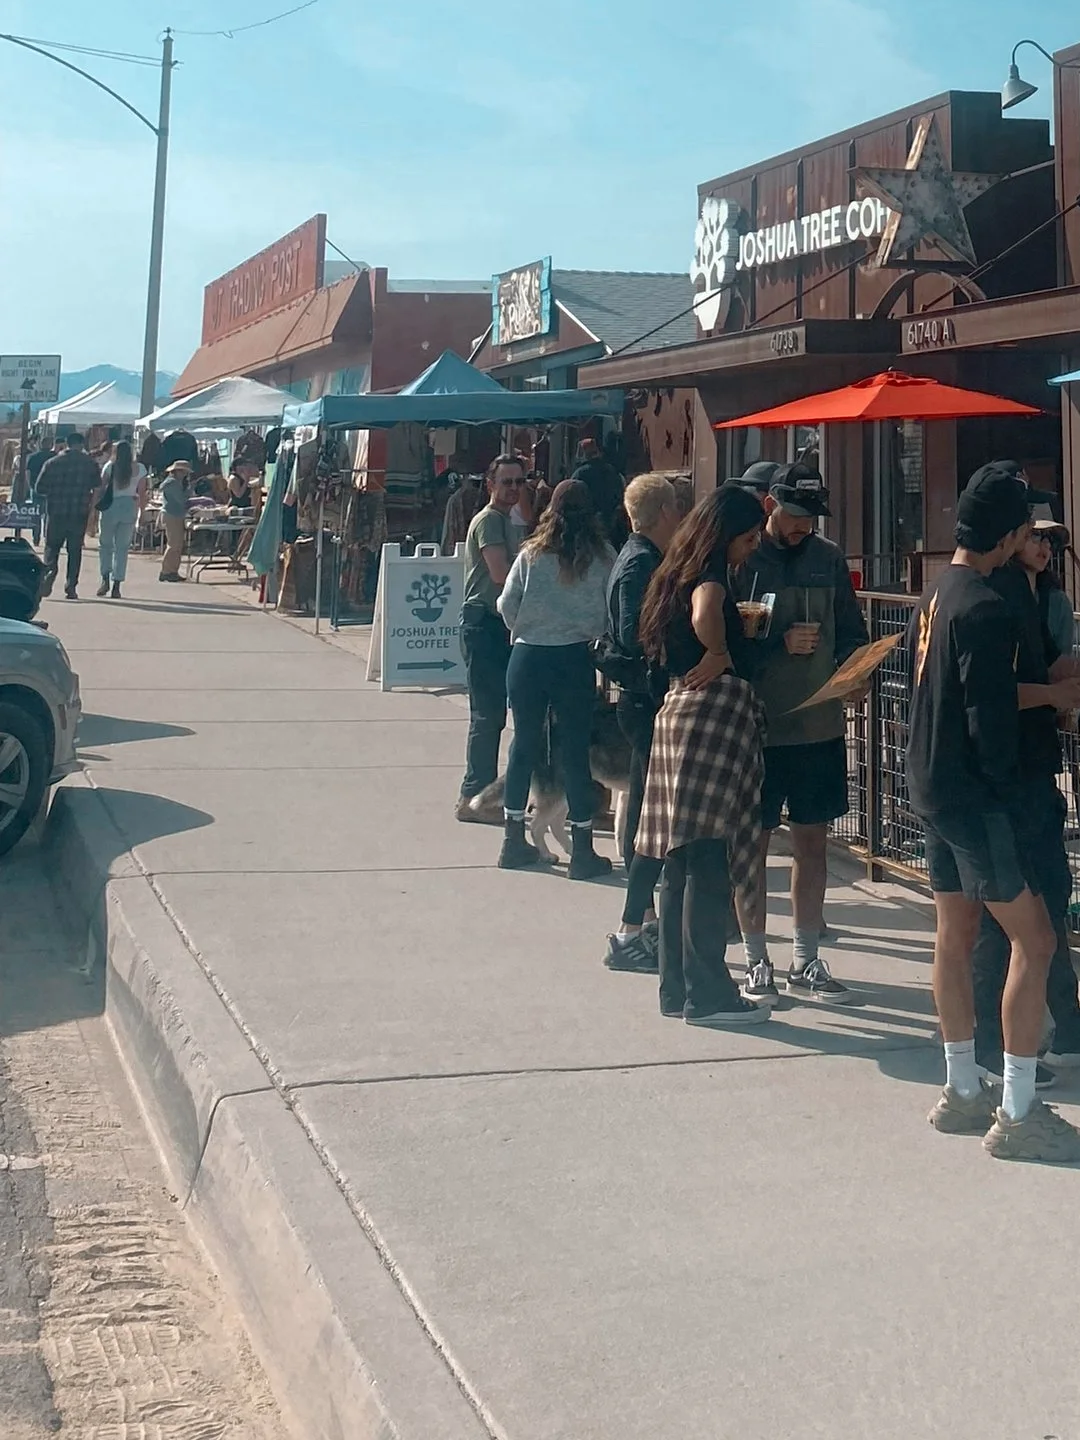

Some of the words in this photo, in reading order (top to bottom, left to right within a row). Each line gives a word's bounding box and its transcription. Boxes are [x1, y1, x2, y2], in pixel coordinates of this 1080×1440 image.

[735, 219, 798, 271] JOSHUA
[801, 205, 842, 252] TREE
[229, 262, 267, 322] TRADING
[271, 240, 303, 300] POST
[769, 330, 794, 351] 61738
[907, 320, 938, 345] 61740
[942, 318, 950, 341] A
[18, 359, 42, 368] BEGIN
[391, 627, 436, 637] JOSHUA
[439, 626, 459, 636] TRE
[406, 639, 449, 649] COFFEE
